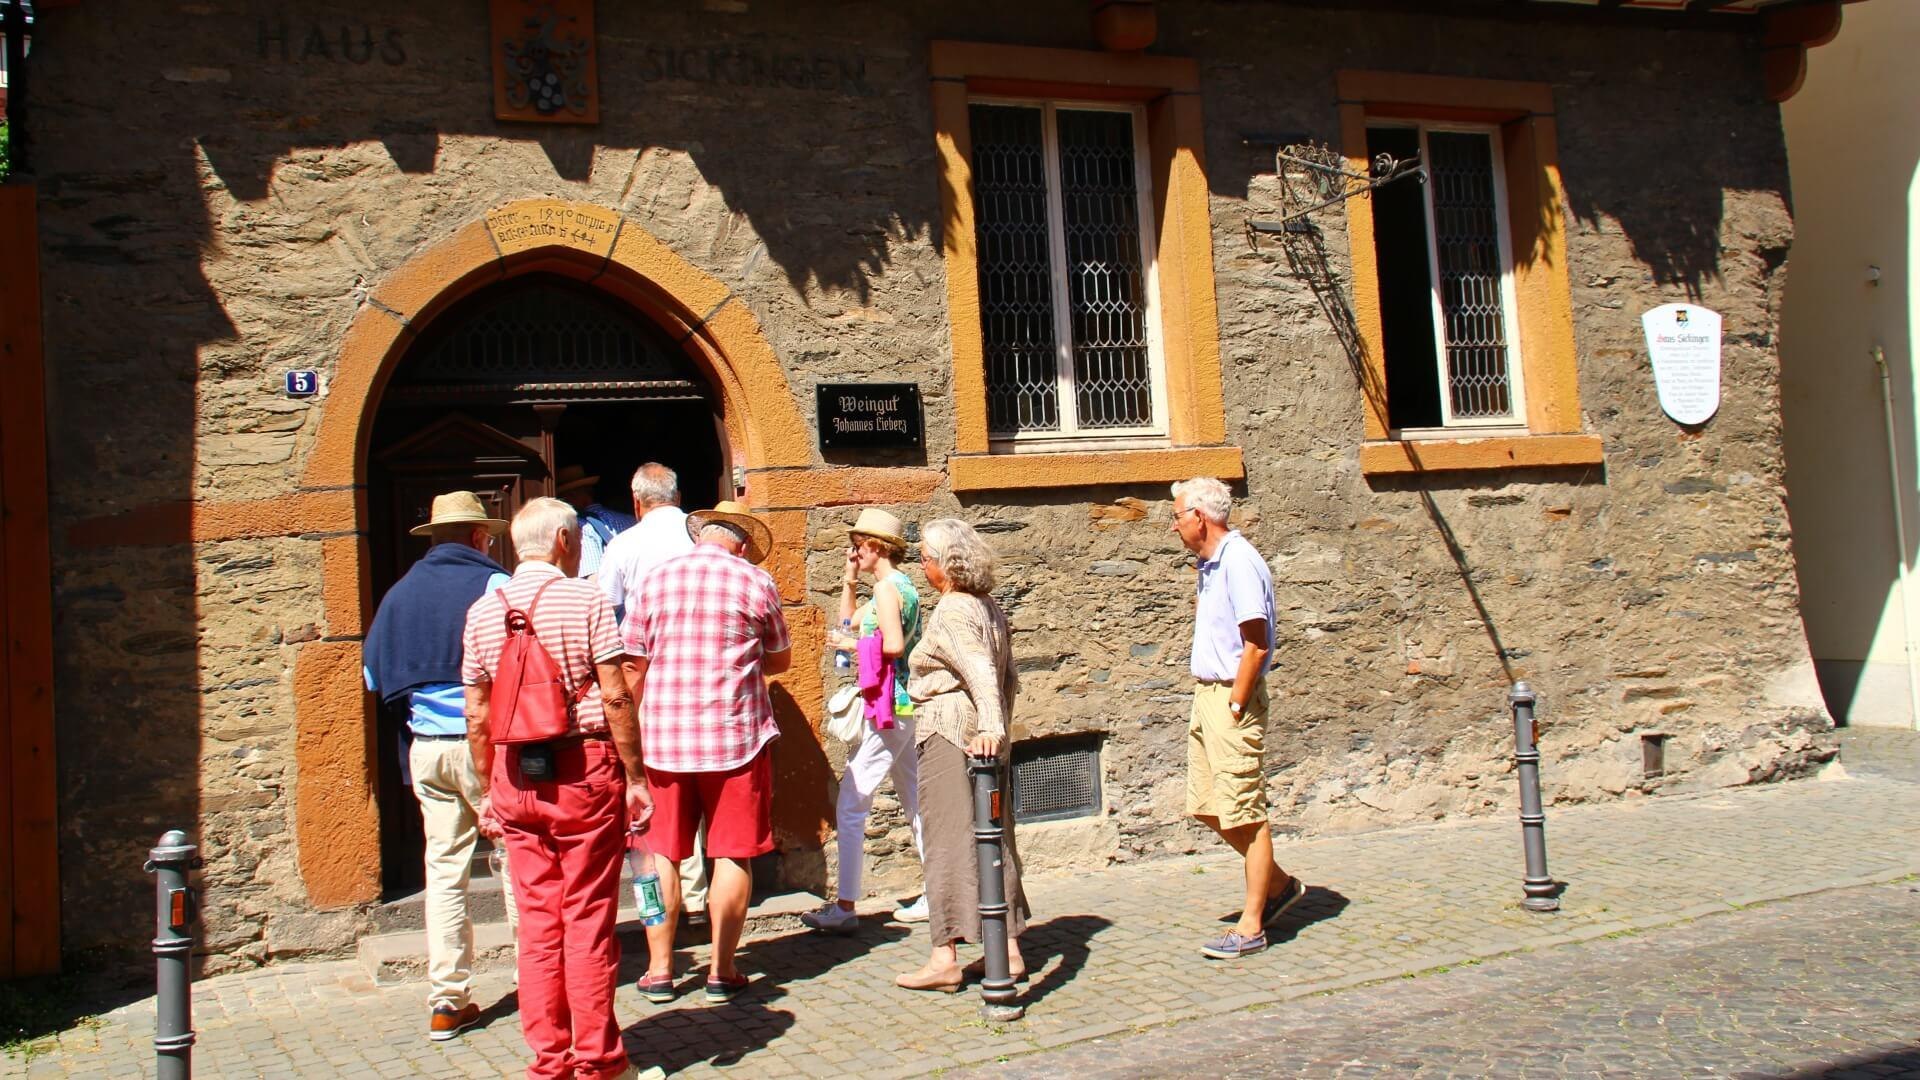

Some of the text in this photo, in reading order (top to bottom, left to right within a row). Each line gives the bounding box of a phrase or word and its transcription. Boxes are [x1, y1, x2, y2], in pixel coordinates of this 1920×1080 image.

[256, 16, 866, 93] HAUS SICKINGEN
[295, 372, 308, 391] 5
[839, 394, 900, 416] Weingut
[832, 416, 907, 434] Johannes Lieberz
